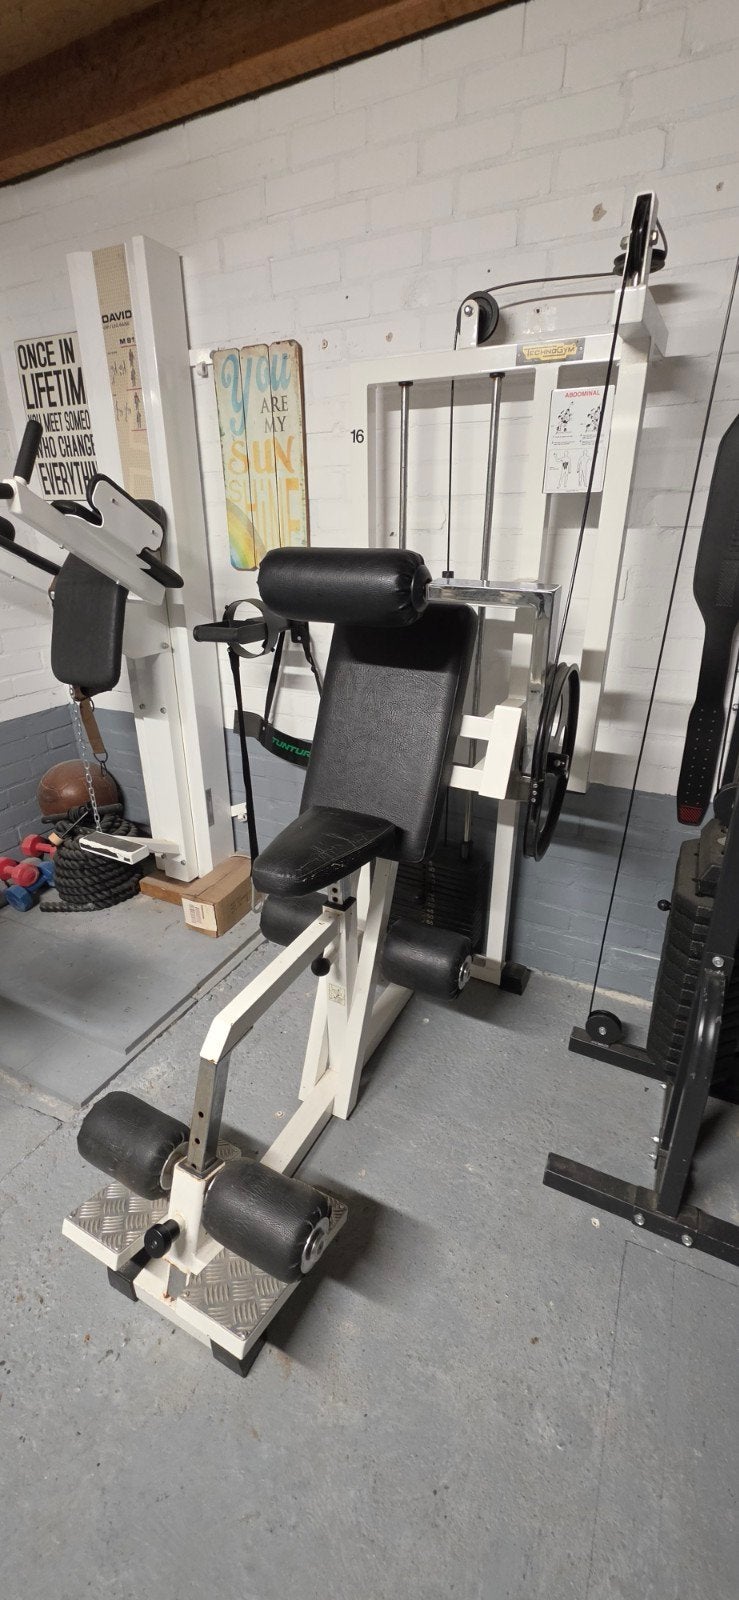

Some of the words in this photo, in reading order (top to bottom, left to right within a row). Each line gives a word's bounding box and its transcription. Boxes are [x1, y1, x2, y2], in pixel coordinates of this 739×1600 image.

[101, 309, 133, 324] DAVID
[17, 340, 57, 371] ONCE
[58, 337, 76, 365] IN
[21, 366, 87, 410] LIFETIM
[564, 389, 601, 399] ABDOMINAL
[259, 394, 289, 414] ARE
[42, 411, 64, 433] MEET
[64, 409, 92, 432] SOMEO
[263, 415, 287, 434] MY
[350, 429, 365, 444] 16
[227, 435, 296, 476] SUN
